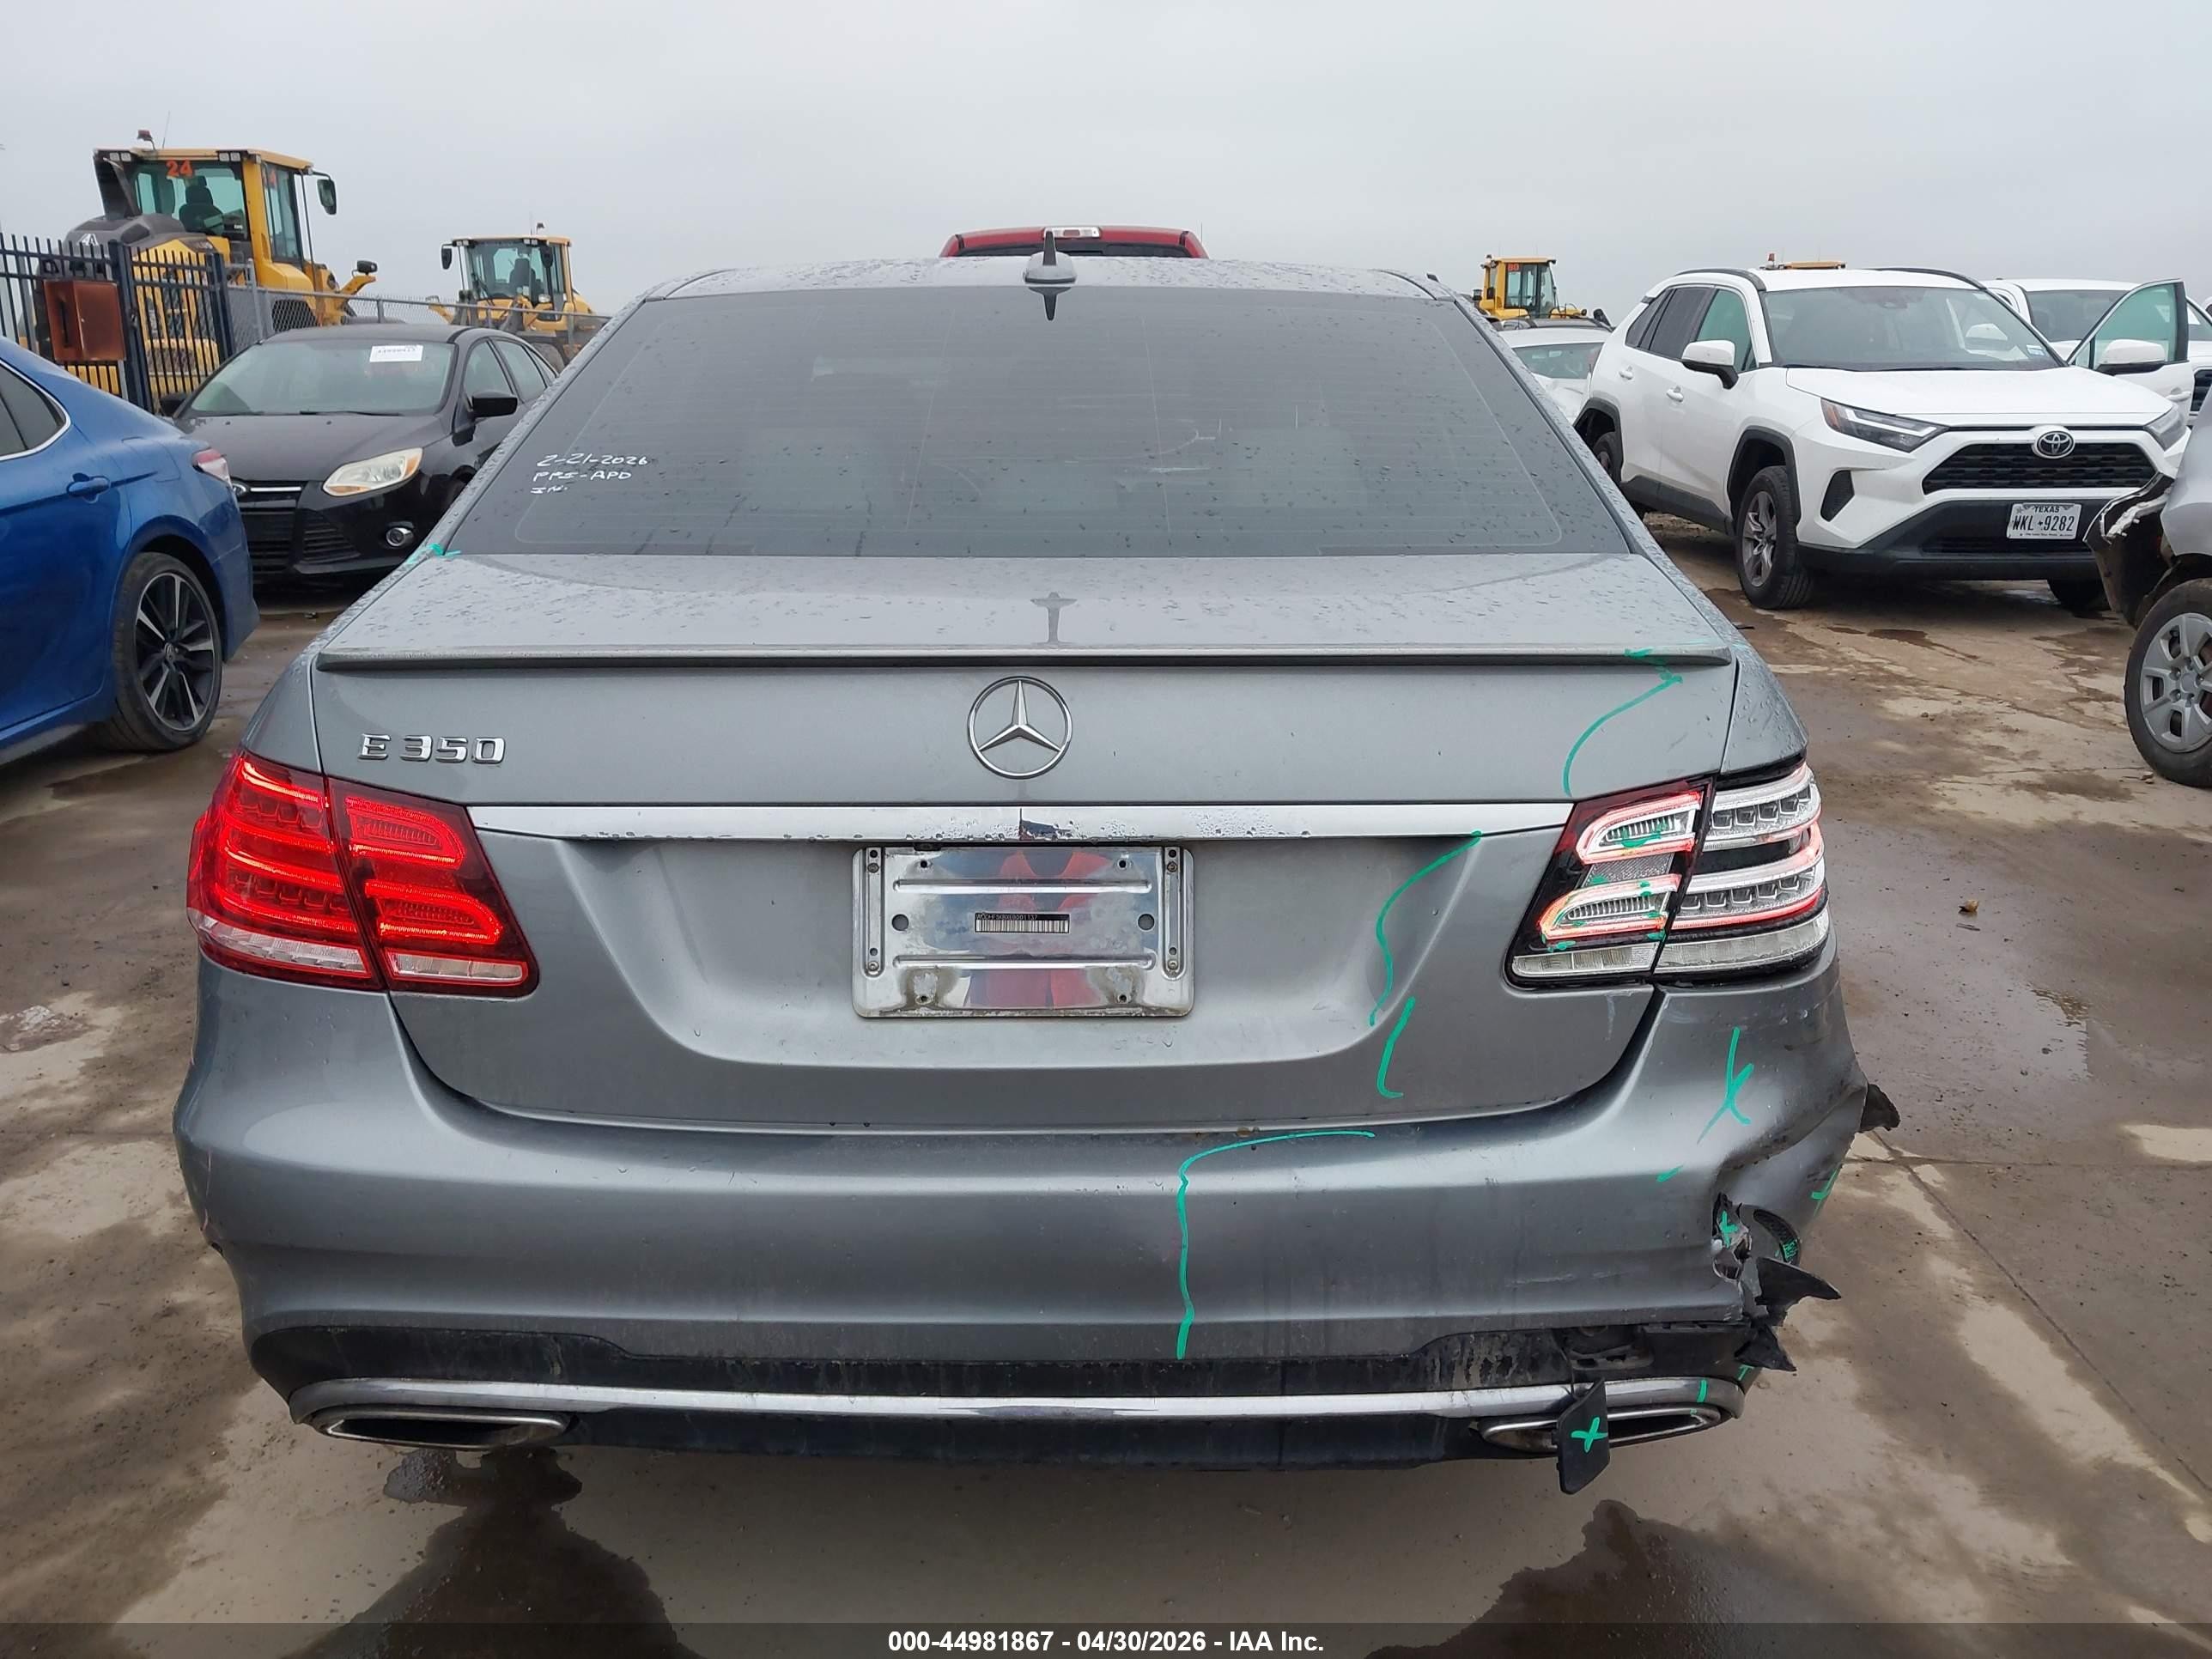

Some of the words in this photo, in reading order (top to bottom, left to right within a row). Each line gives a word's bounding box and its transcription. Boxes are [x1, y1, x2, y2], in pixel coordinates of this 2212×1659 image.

[166, 160, 193, 177] 24
[537, 453, 648, 467] 2-21-2026
[2012, 515, 2034, 531] WKL
[2043, 516, 2075, 532] 9282
[357, 732, 392, 760] E
[399, 735, 506, 764] 350
